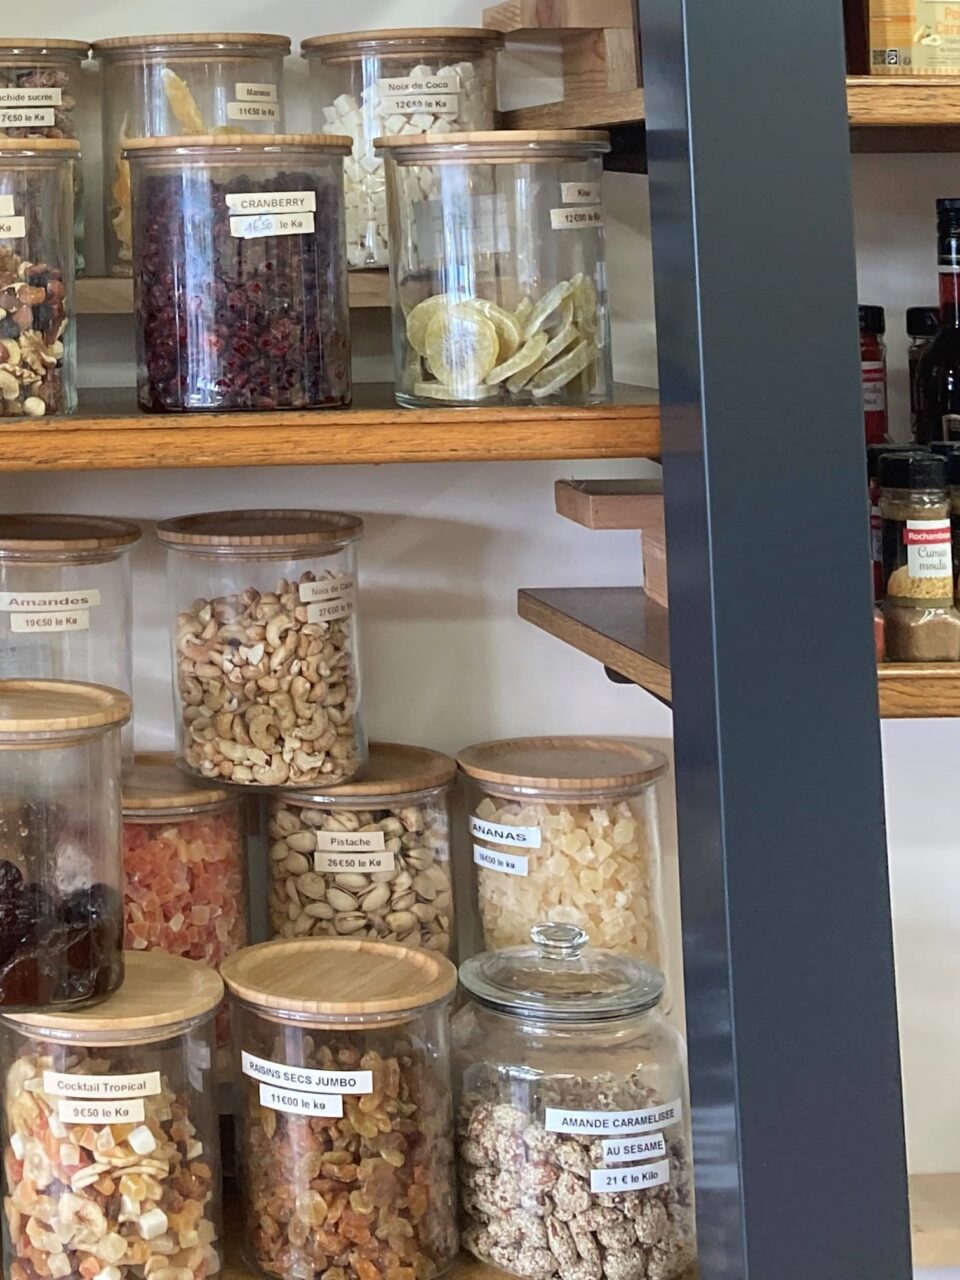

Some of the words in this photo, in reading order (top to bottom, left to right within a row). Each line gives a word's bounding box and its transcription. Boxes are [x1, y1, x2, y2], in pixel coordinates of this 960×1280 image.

[388, 83, 410, 91] Noix
[425, 81, 449, 89] Coco
[24, 113, 33, 122] le
[240, 197, 305, 209] CRANBERRY
[279, 220, 289, 229] le
[8, 596, 89, 607] Amandes
[472, 823, 527, 842] ANANAS
[330, 837, 371, 847] Pistache
[327, 858, 356, 868] 26€50
[358, 859, 367, 868] le
[249, 1061, 281, 1079] RAISINS
[283, 1072, 312, 1085] SECS
[315, 1077, 357, 1088] JUMBO
[57, 1080, 100, 1092] Cocktail
[102, 1080, 147, 1093] Tropical
[271, 1093, 298, 1107] 11€00
[301, 1098, 310, 1110] le
[73, 1107, 99, 1118] 9€50
[102, 1108, 112, 1118] le
[561, 1117, 610, 1129] AMANDE
[612, 1107, 675, 1128] CARAMELISEE
[606, 1146, 621, 1157] AU
[623, 1140, 663, 1155] SESAME
[606, 1176, 618, 1186] 21
[621, 1175, 628, 1185] €
[630, 1173, 640, 1183] le
[641, 1170, 659, 1181] Kilo
